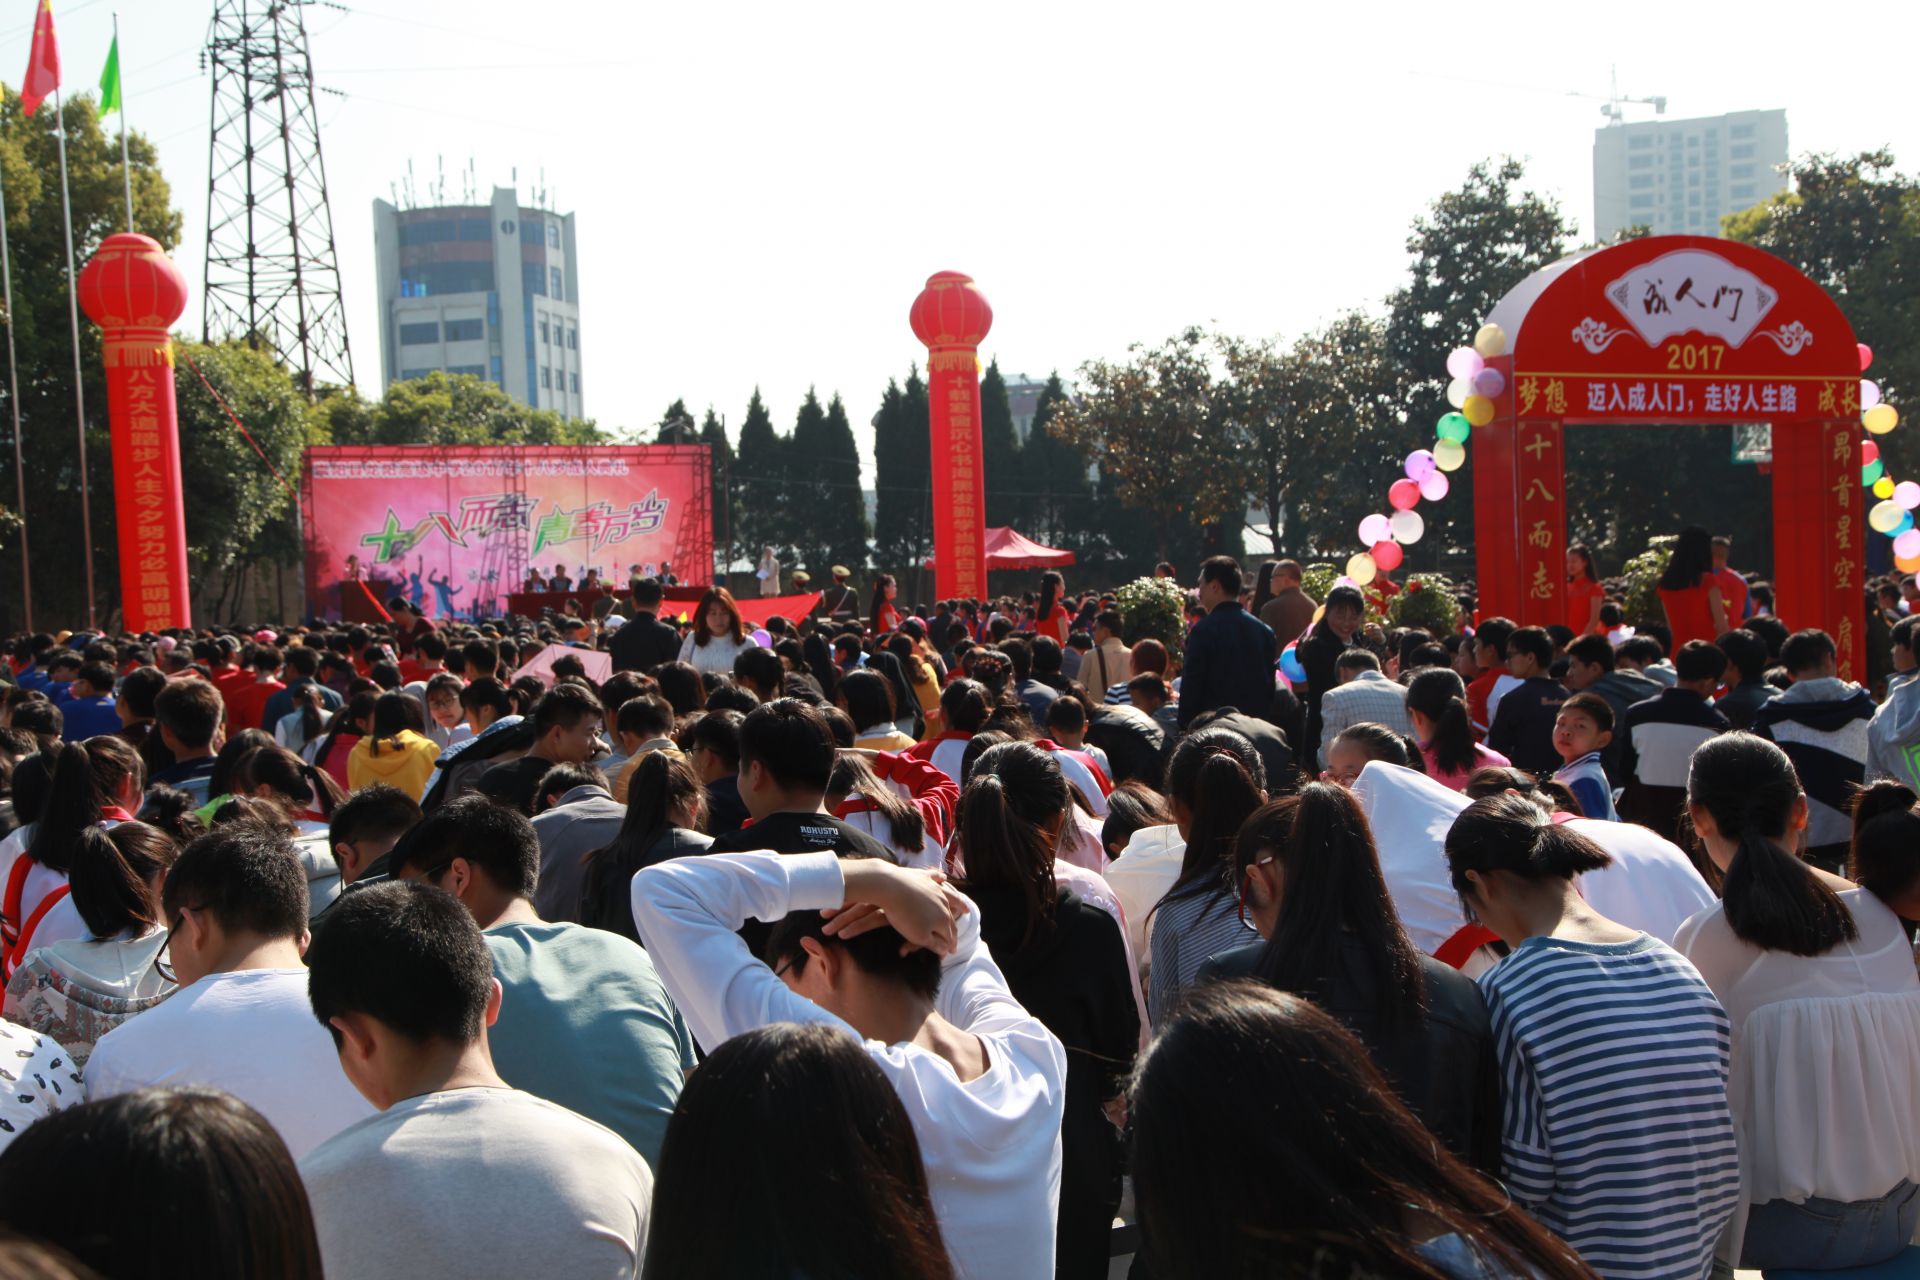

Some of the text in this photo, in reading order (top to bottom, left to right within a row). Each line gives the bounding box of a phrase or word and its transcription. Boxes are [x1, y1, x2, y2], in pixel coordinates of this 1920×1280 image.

[1642, 276, 1744, 323] 成人门
[1667, 343, 1725, 370] 2017
[1518, 376, 1568, 416] 梦想
[1818, 380, 1861, 418] 成长
[1524, 433, 1554, 600] 十八而志
